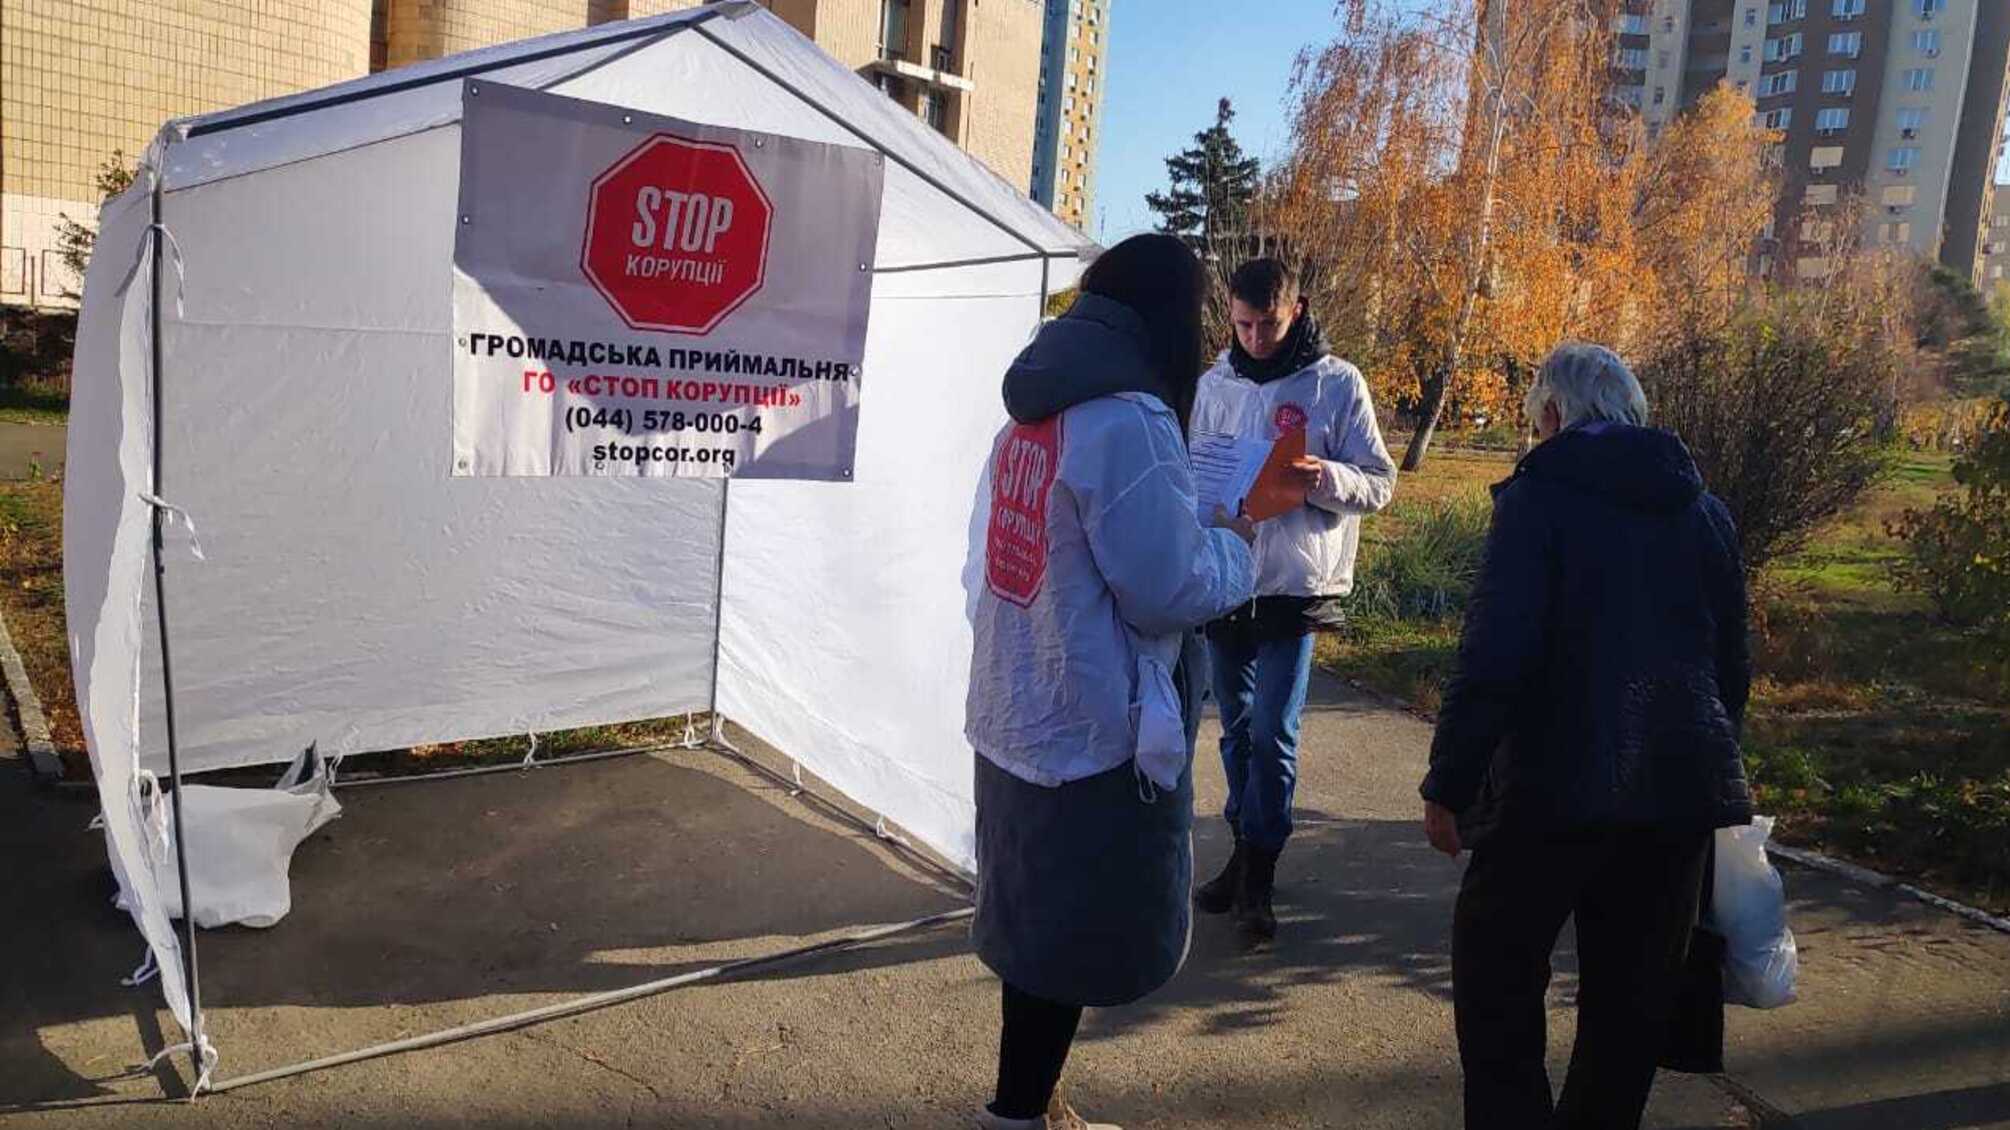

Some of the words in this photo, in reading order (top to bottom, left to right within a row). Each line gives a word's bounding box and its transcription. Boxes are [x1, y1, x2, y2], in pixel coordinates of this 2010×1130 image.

[632, 185, 734, 254] STOP
[625, 254, 728, 287] КОРУПЦІЇ
[470, 333, 662, 367] ГРОМАДСЬКА
[669, 349, 849, 381] ПРИЙМАЛЬНЯ
[523, 371, 556, 393] ГО
[567, 374, 659, 398] «СТОП
[666, 380, 801, 408] КОРУПЦІЇ»
[565, 407, 633, 434] (044)
[643, 411, 762, 434] 578-000-4
[593, 441, 735, 466] stopcor.org
[1001, 436, 1047, 511] STOP
